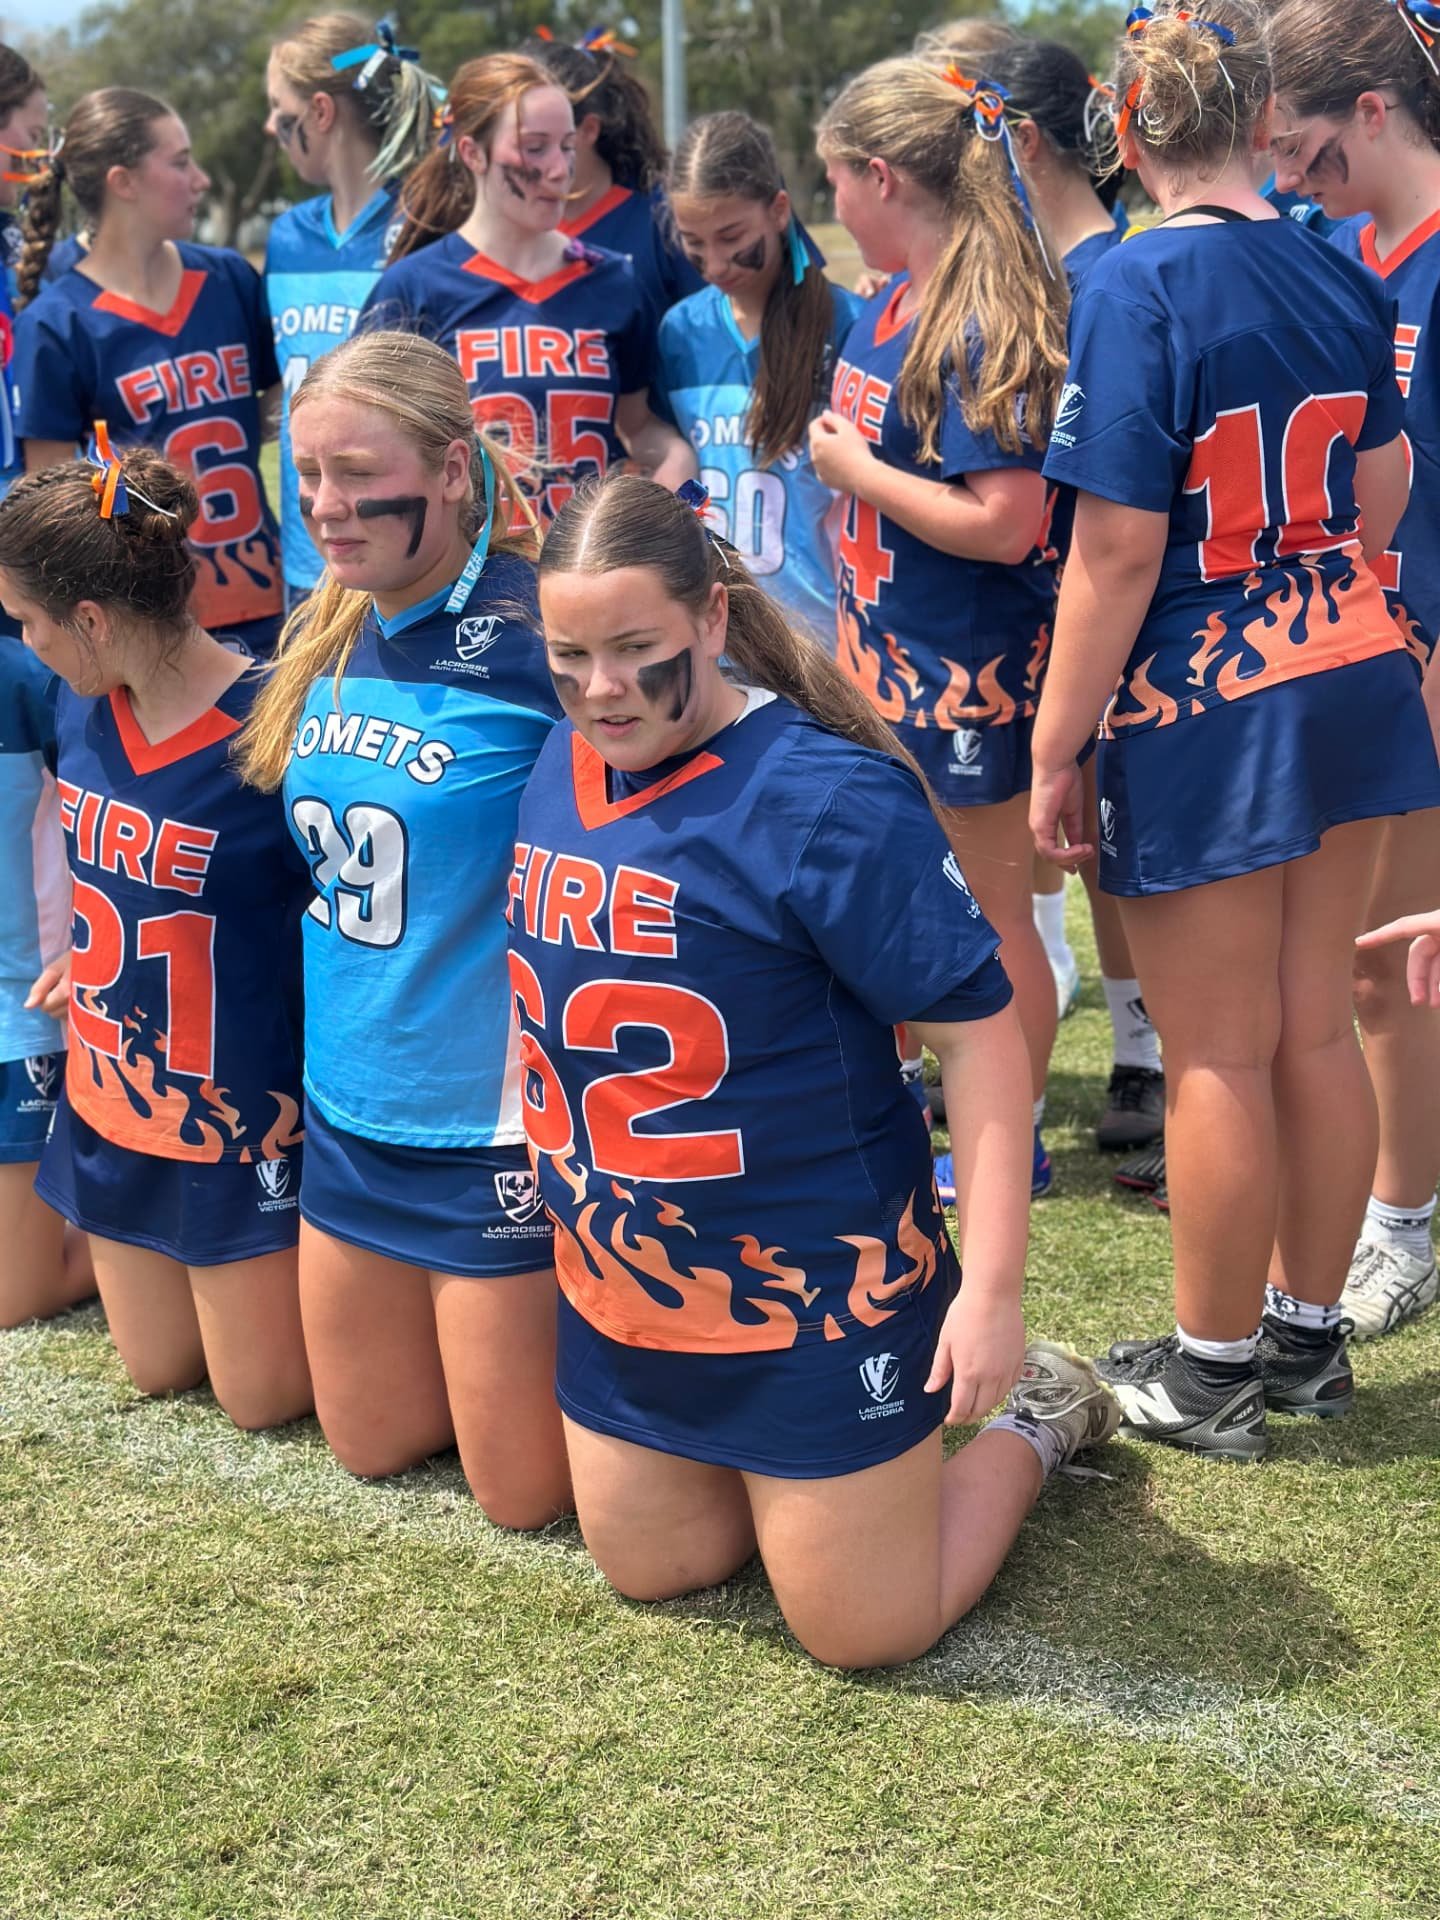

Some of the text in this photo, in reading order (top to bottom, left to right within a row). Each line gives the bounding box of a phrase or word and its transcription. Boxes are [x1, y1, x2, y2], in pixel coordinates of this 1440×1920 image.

[115, 343, 251, 424] FIRE
[456, 325, 611, 384] FIRE
[163, 416, 264, 548] 6
[1182, 390, 1369, 584] 10
[447, 580, 473, 609] ISLA
[429, 664, 490, 680] SOUTH AUSTRALIA
[435, 659, 489, 674] LACROSSE
[291, 711, 457, 785] OMETS
[57, 777, 220, 897] FIRE
[292, 795, 410, 950] 29
[505, 842, 681, 960] FIRE
[69, 870, 217, 1080] 21
[507, 948, 746, 1183] 62
[487, 1224, 553, 1234] LACROSSE
[858, 1399, 905, 1415] LACROSSE
[860, 1406, 905, 1421] VICTORIA
